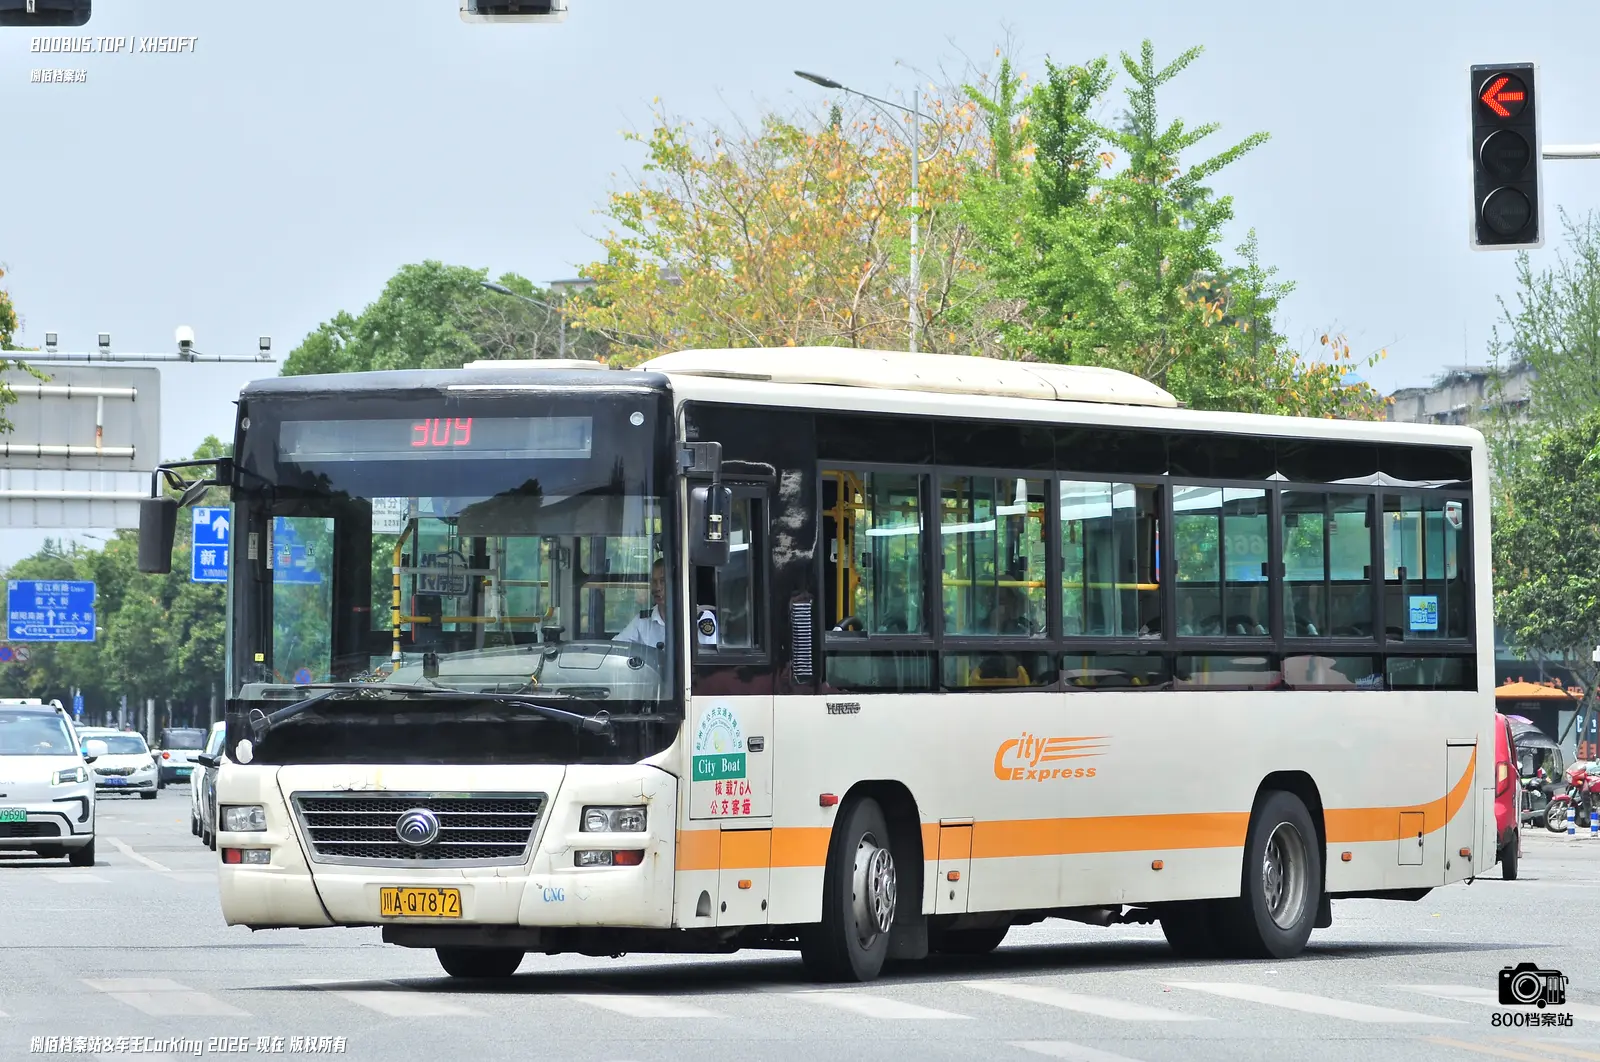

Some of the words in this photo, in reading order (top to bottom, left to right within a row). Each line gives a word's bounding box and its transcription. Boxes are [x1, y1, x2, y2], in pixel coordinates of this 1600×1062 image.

[994, 731, 1047, 781] City
[698, 759, 716, 776] City
[721, 757, 741, 772] Boat
[1011, 767, 1096, 782] Express
[714, 779, 752, 796] 核载76人
[710, 798, 751, 816] 公交客运
[543, 887, 565, 902] CNG
